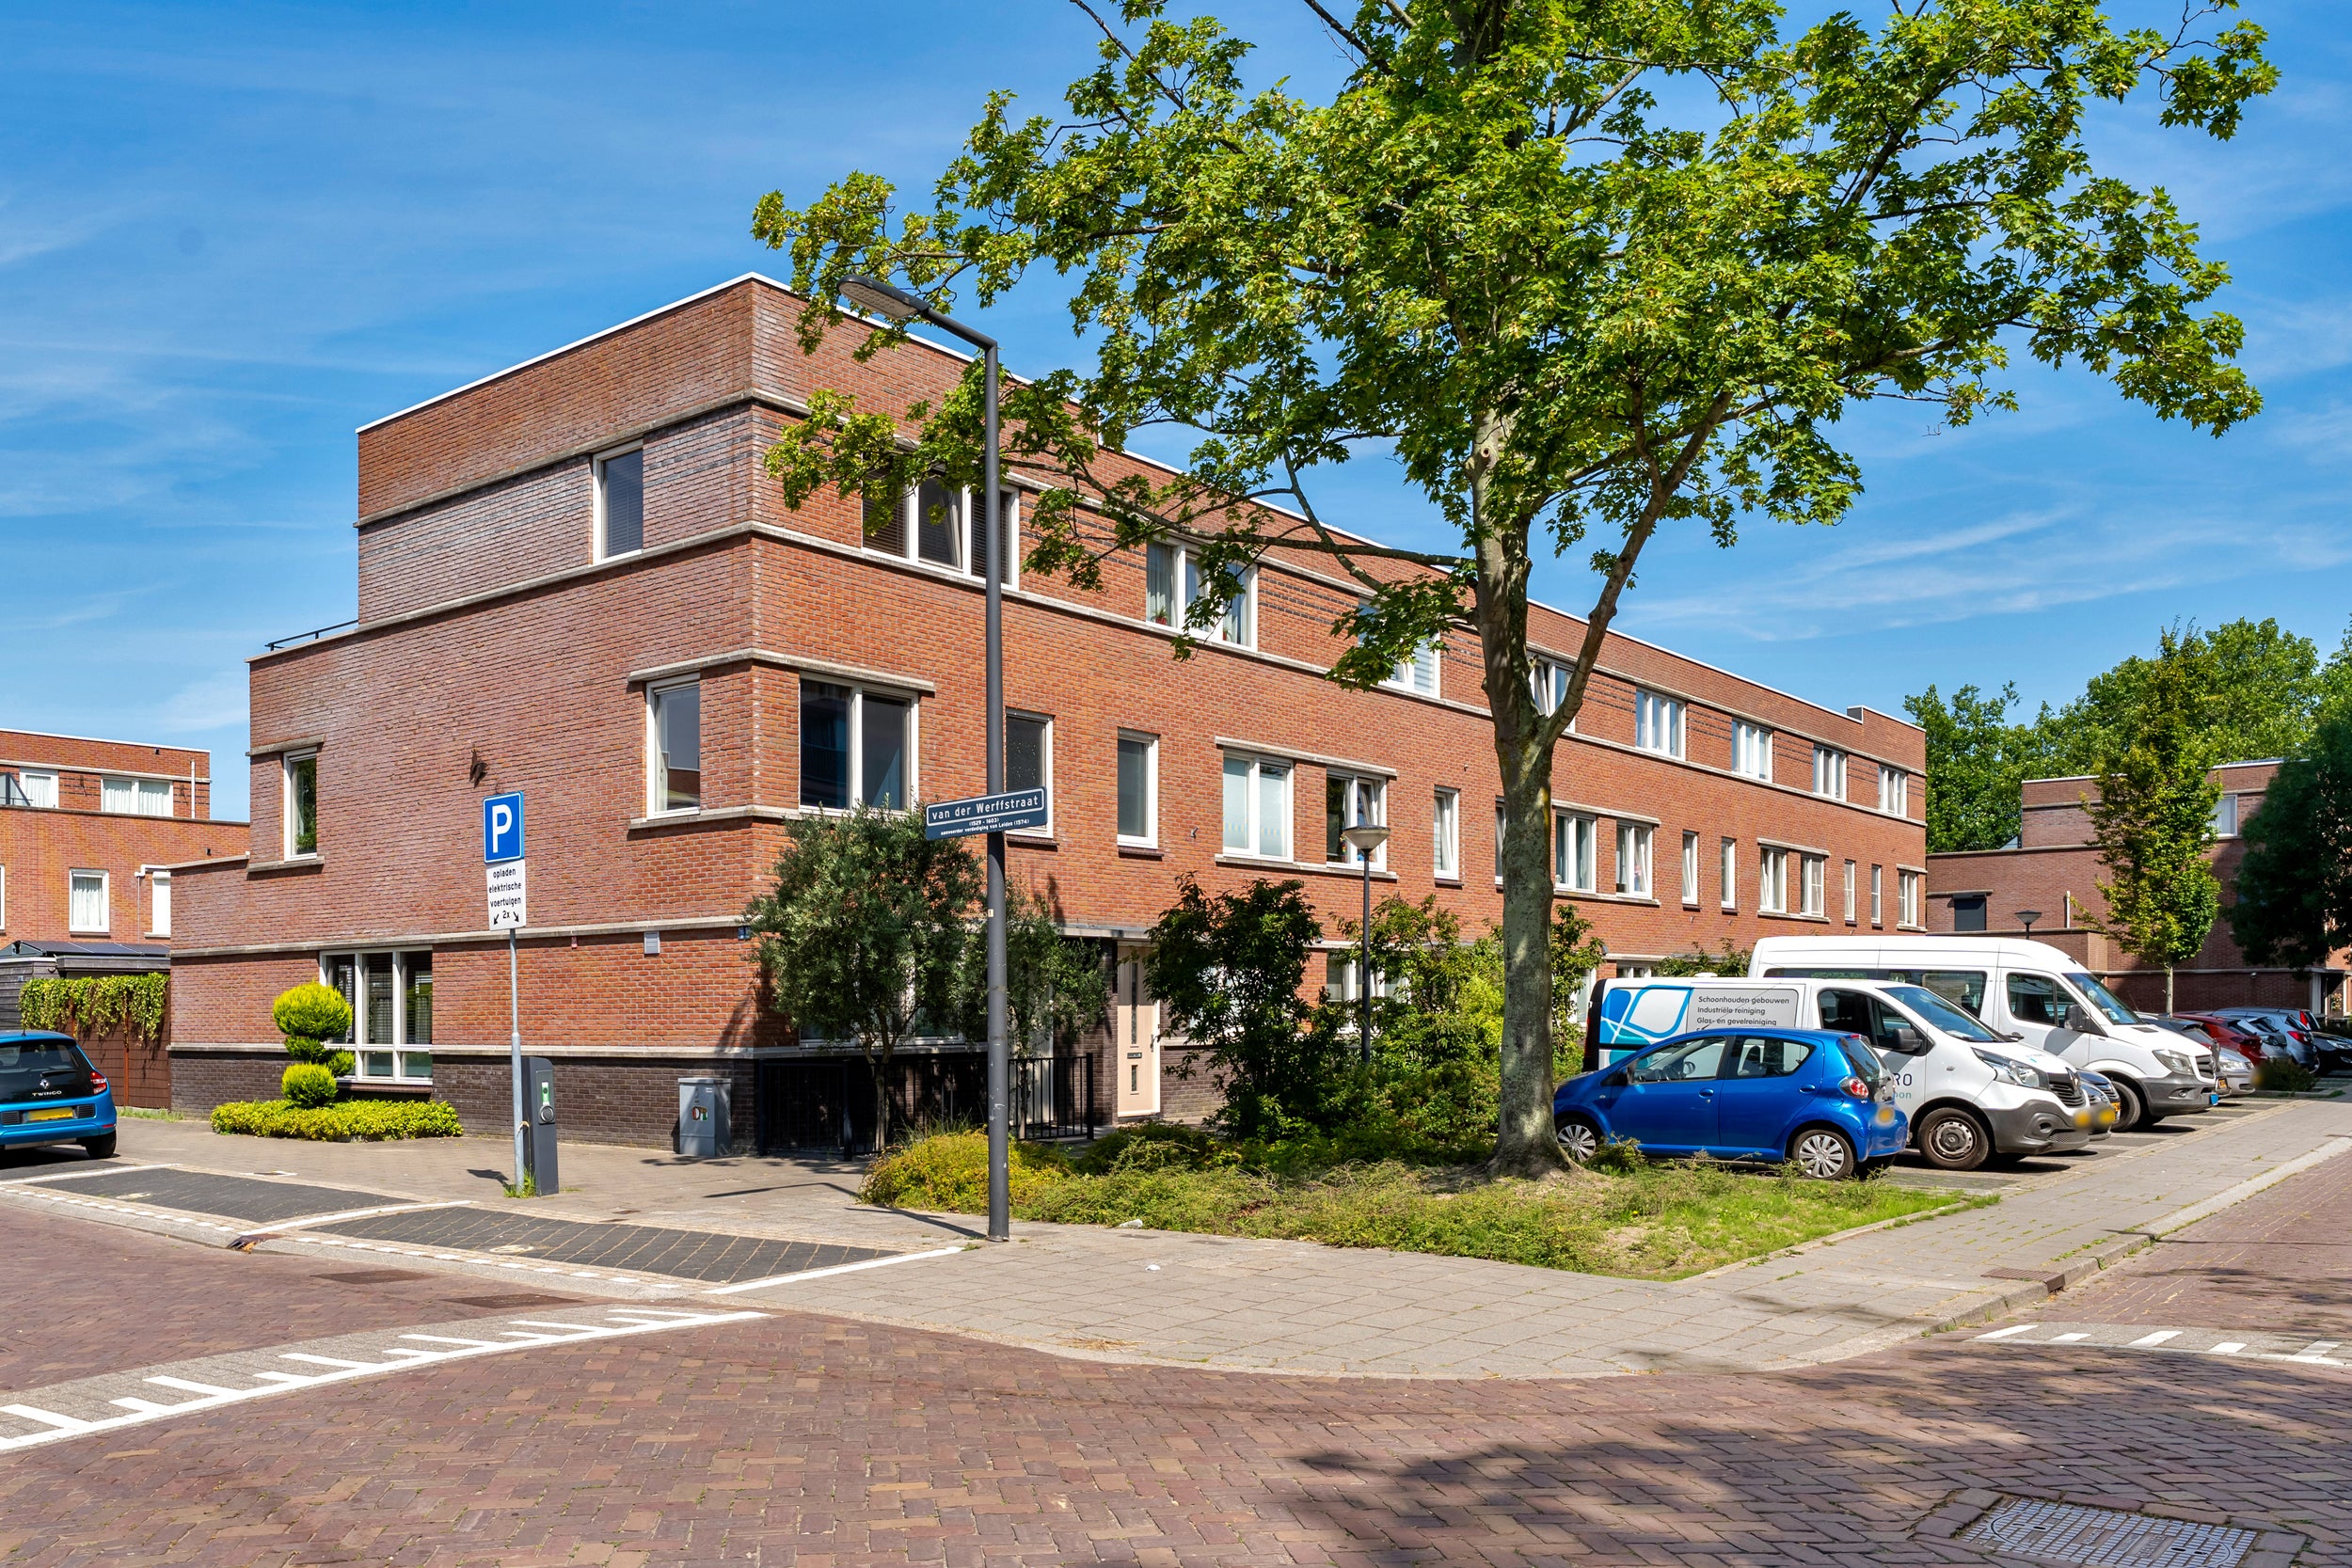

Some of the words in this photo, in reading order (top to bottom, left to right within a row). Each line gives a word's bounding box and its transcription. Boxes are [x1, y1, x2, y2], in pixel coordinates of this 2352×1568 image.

[931, 810, 950, 820] van
[954, 806, 971, 816] der
[976, 795, 1039, 814] Werffstraat
[491, 803, 513, 854] P
[492, 868, 516, 879] opladen
[488, 881, 521, 894] elektrische
[489, 896, 521, 908] voertuigen
[501, 910, 510, 919] 2x
[1698, 995, 1750, 1004] Schoonhouden
[1751, 996, 1789, 1005] gebouwen
[1697, 1006, 1733, 1014] Industriële
[1735, 1006, 1766, 1015] reiniging
[1727, 1018, 1777, 1026] gevelreiniging
